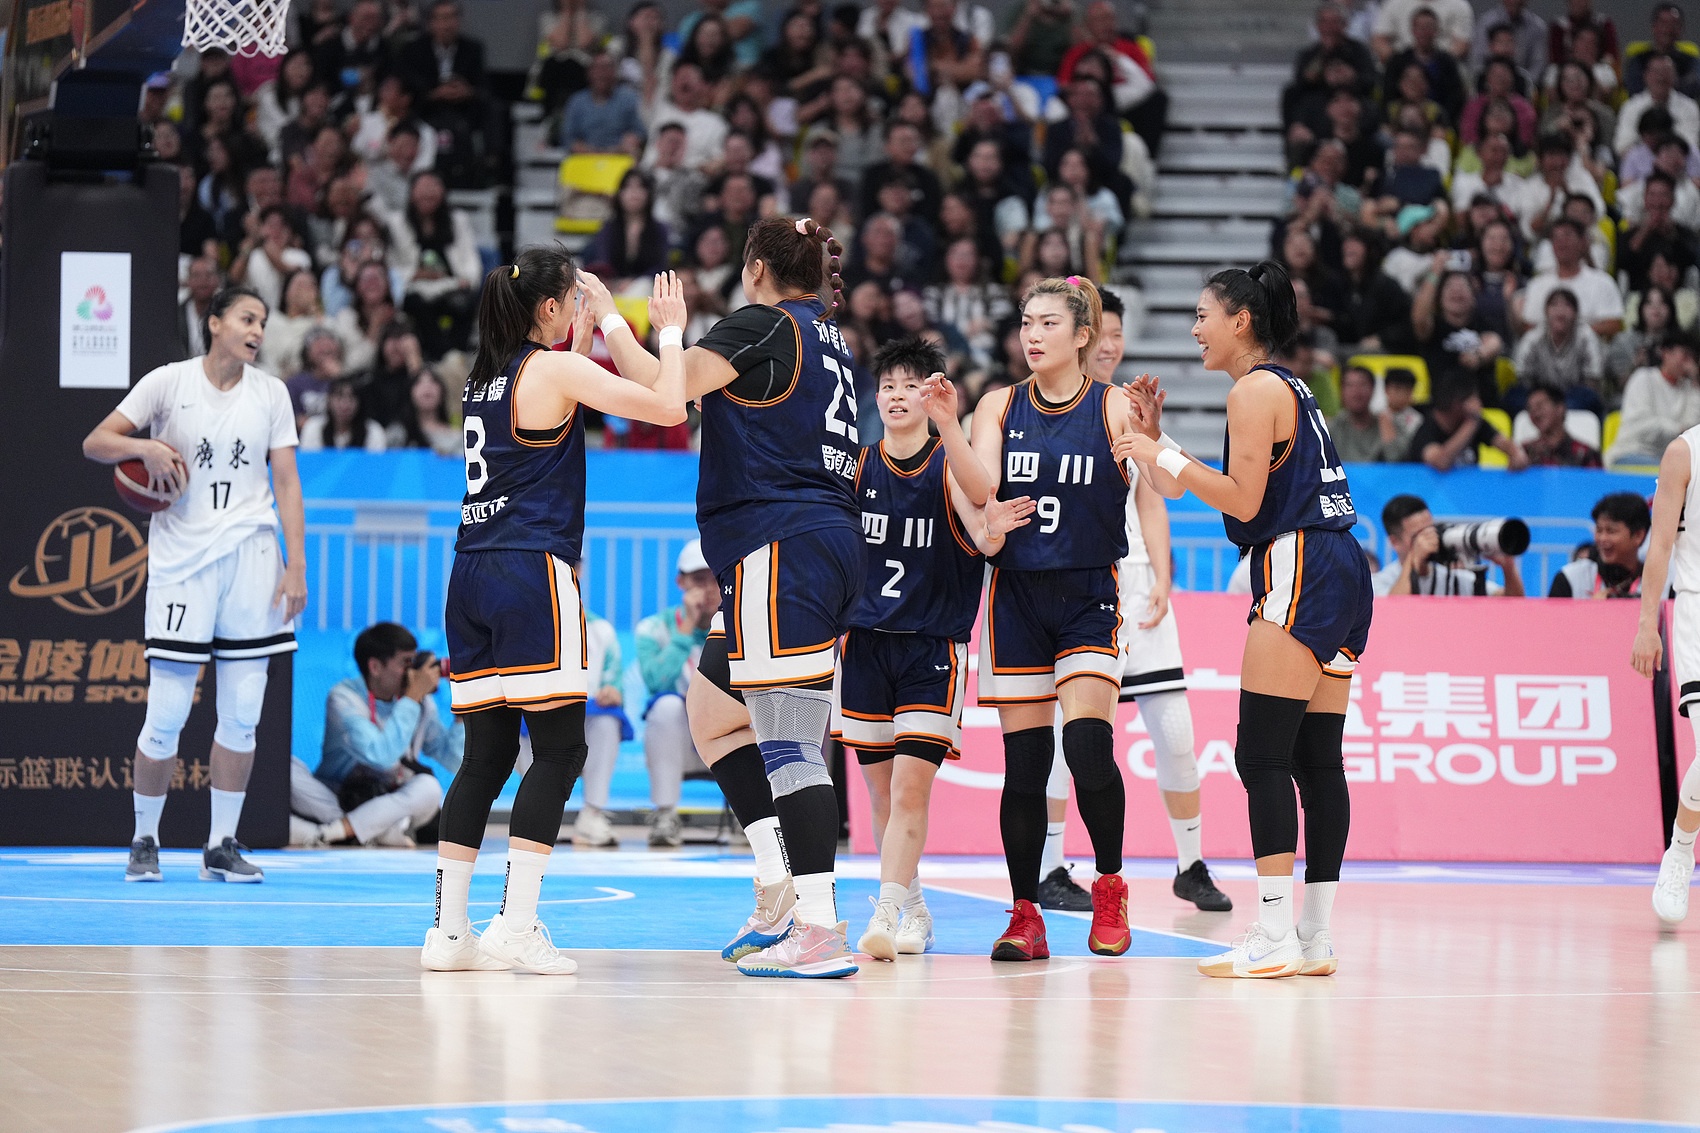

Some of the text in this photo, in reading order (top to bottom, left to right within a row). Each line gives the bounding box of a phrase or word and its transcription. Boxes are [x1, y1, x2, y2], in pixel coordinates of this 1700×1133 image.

[822, 354, 859, 445] 23
[463, 415, 489, 495] 8
[1007, 451, 1094, 486] 四川
[209, 481, 231, 510] 17
[1037, 495, 1061, 534] 9
[861, 511, 934, 548] 四川
[880, 559, 905, 598] 2
[165, 602, 187, 632] 17
